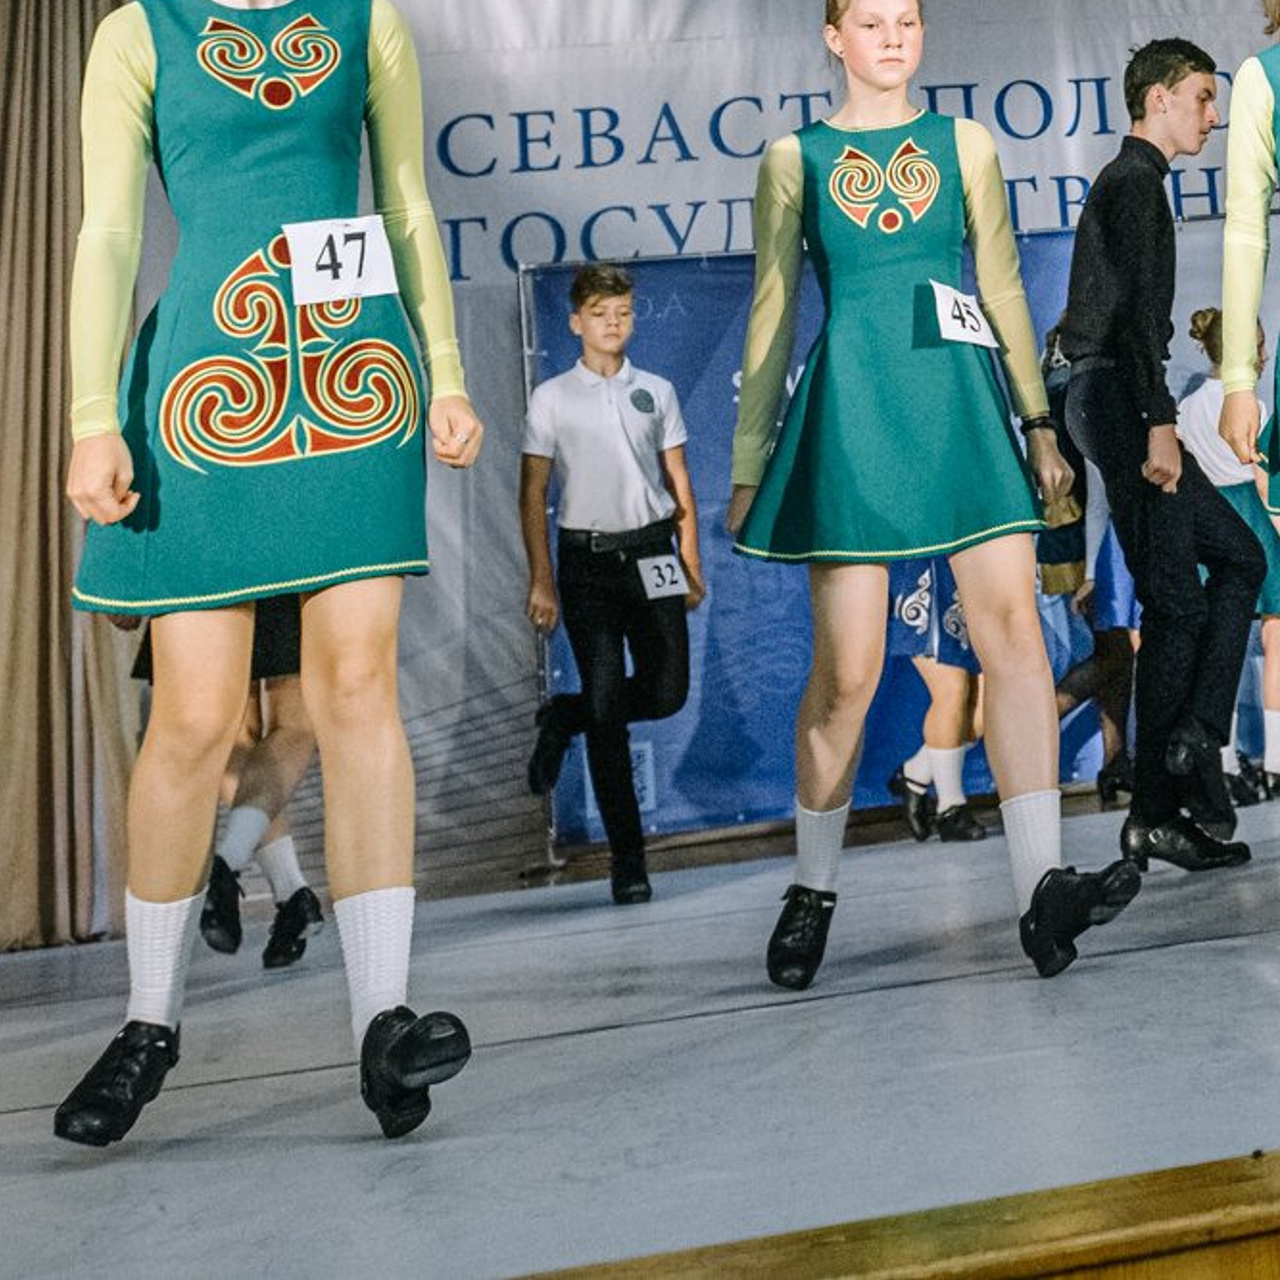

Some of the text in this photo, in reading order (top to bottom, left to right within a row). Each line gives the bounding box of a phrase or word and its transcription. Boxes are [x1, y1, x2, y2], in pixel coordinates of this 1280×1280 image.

[314, 231, 367, 280] 47
[951, 297, 981, 332] 45
[650, 563, 679, 588] 32
